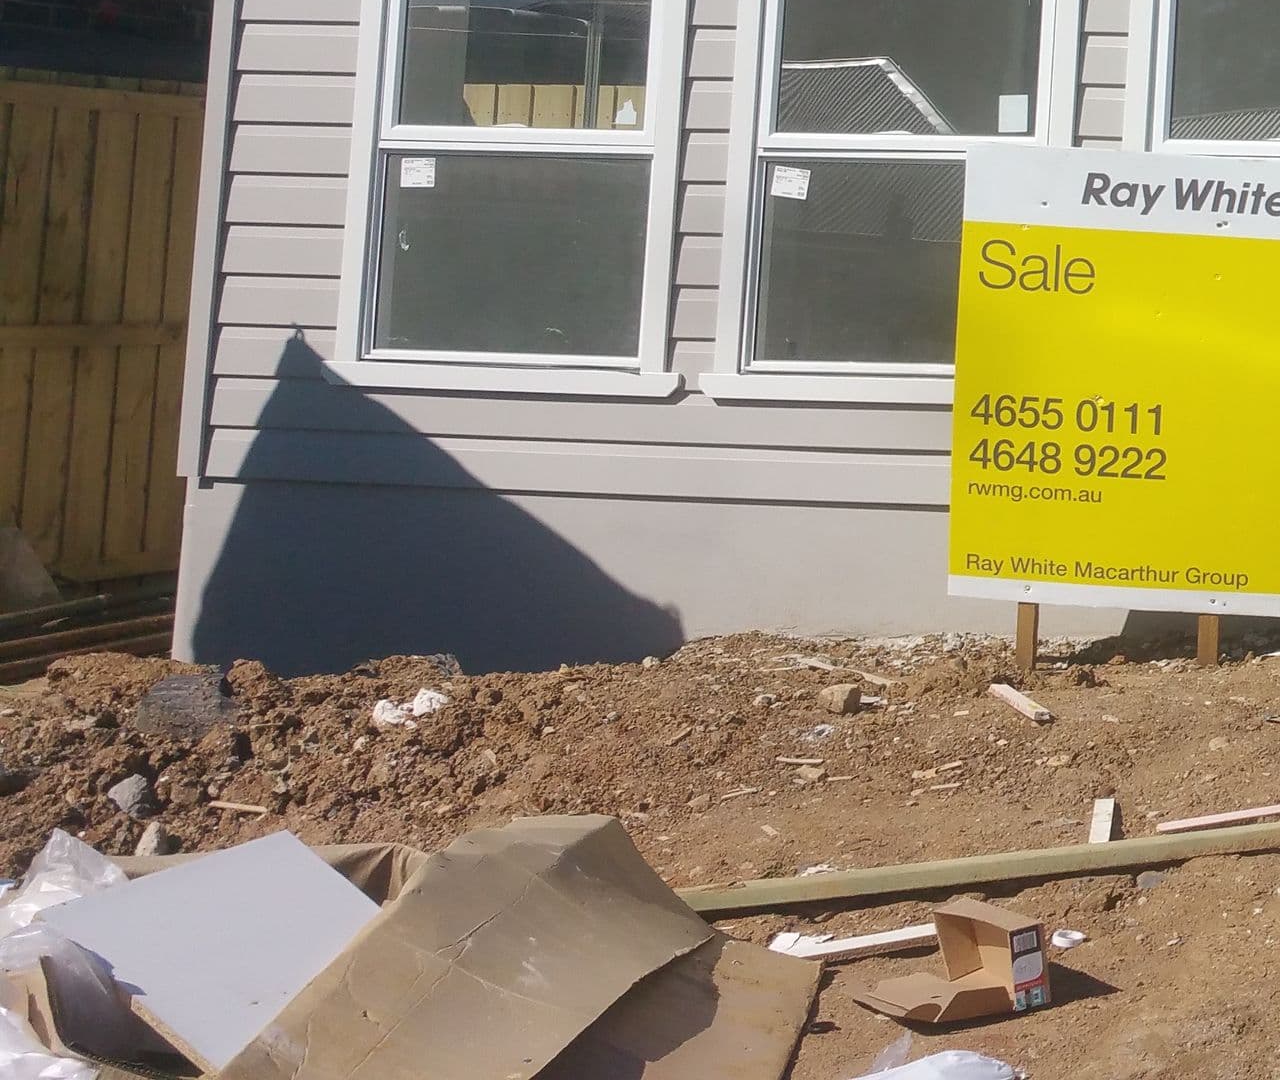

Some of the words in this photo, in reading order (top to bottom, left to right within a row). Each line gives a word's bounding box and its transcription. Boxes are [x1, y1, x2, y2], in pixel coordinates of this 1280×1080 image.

[1081, 172, 1167, 216] Ray
[978, 239, 1096, 295] Sale
[970, 393, 1064, 430] 4655
[1075, 399, 1162, 436] 0111
[968, 438, 1062, 475] 4648
[1074, 444, 1167, 481] 9222
[967, 482, 1102, 503] rwmg.com.au
[966, 553, 1004, 576] Ray
[1010, 556, 1068, 577] White
[1074, 561, 1180, 583] Macarthur
[1185, 567, 1249, 590] Group
